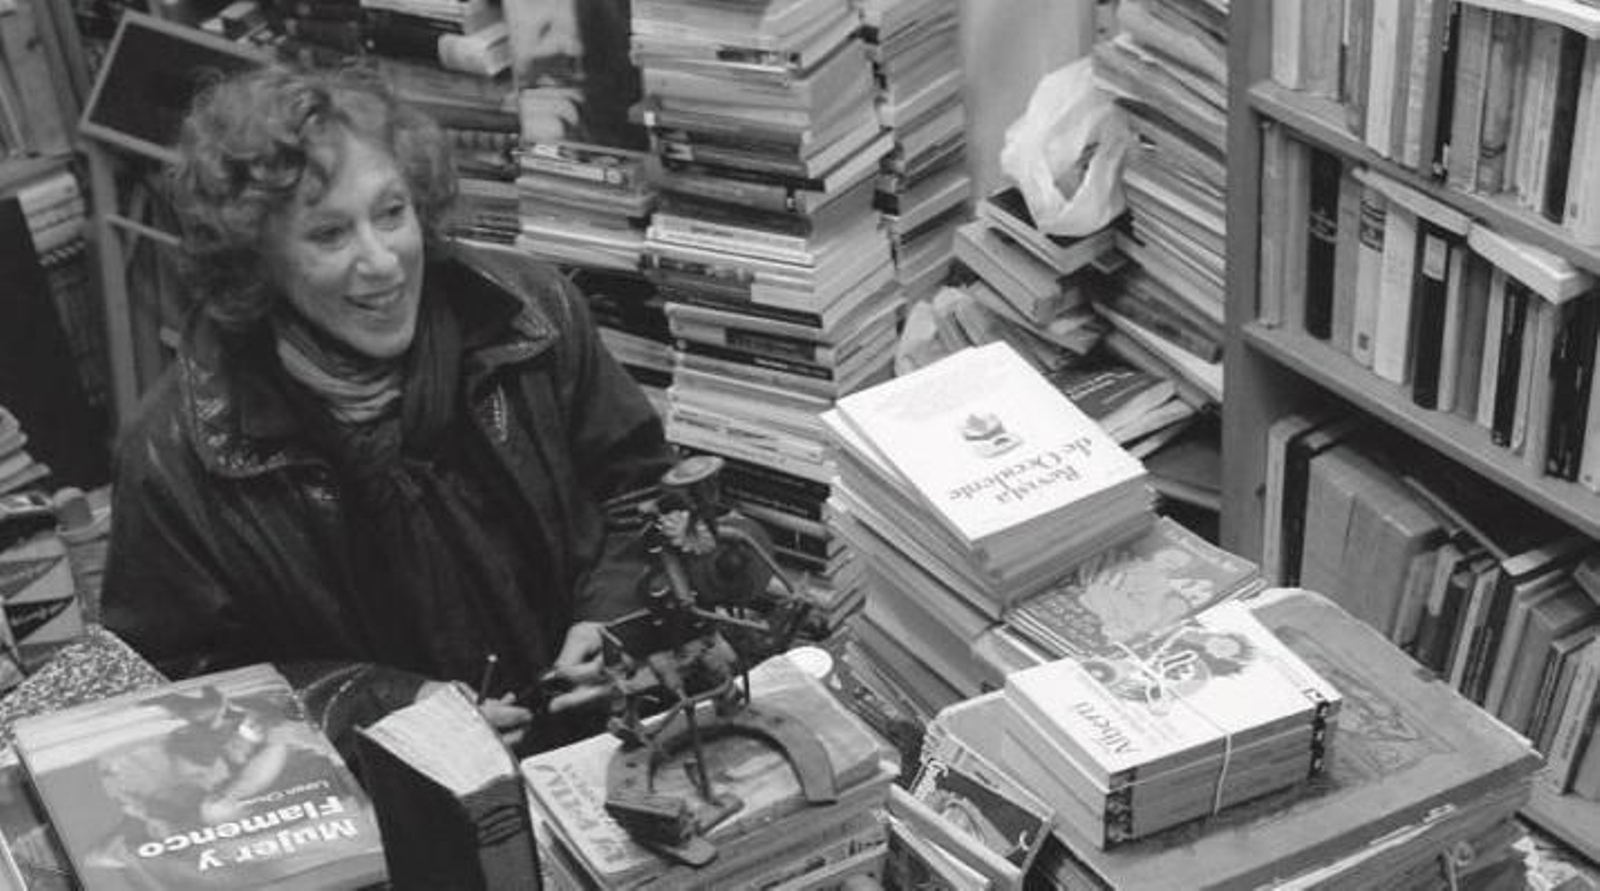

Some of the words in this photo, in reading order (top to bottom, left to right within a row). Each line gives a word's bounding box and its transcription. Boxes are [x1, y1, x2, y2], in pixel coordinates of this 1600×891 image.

[1061, 436, 1092, 459] de
[137, 795, 345, 858] Flamenco
[235, 818, 358, 863] Mujer
[199, 848, 224, 871] y
